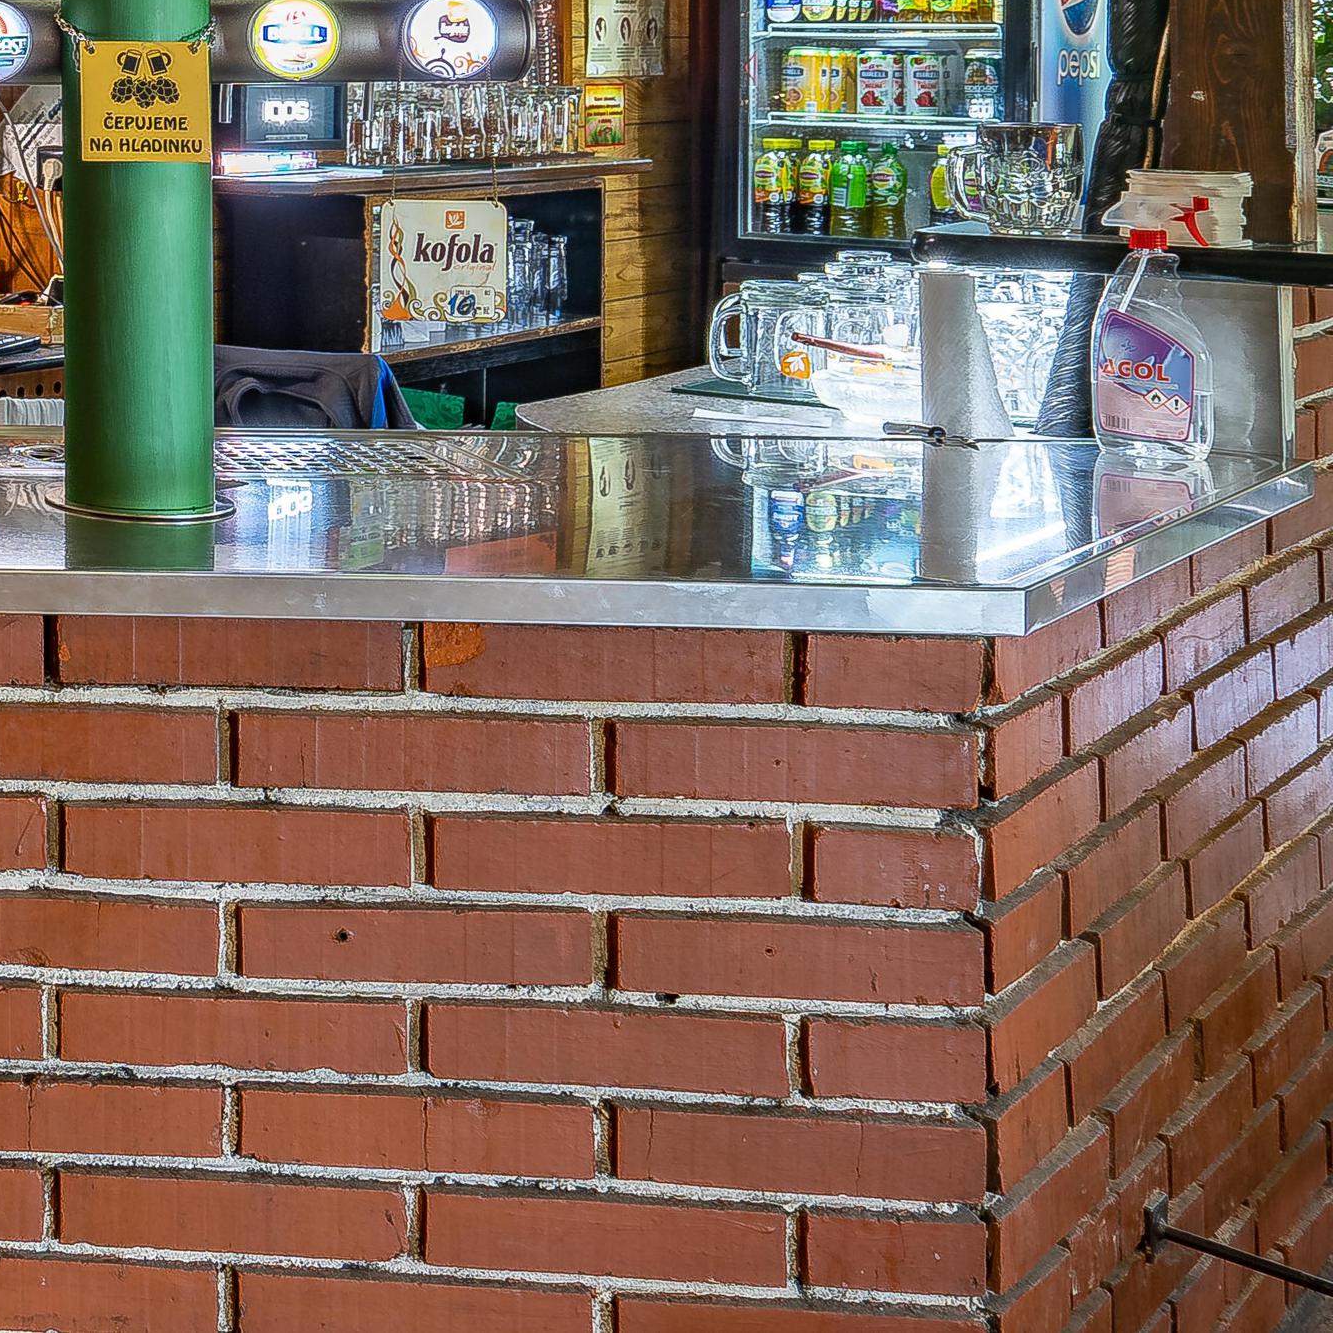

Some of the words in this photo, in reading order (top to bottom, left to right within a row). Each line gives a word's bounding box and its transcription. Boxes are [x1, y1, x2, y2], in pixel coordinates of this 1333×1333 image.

[1057, 44, 1101, 85] pepsi
[103, 112, 188, 131] ČEPUJEME
[89, 137, 113, 152] NA
[119, 138, 203, 153] HLADINKU
[413, 233, 495, 271] kofola
